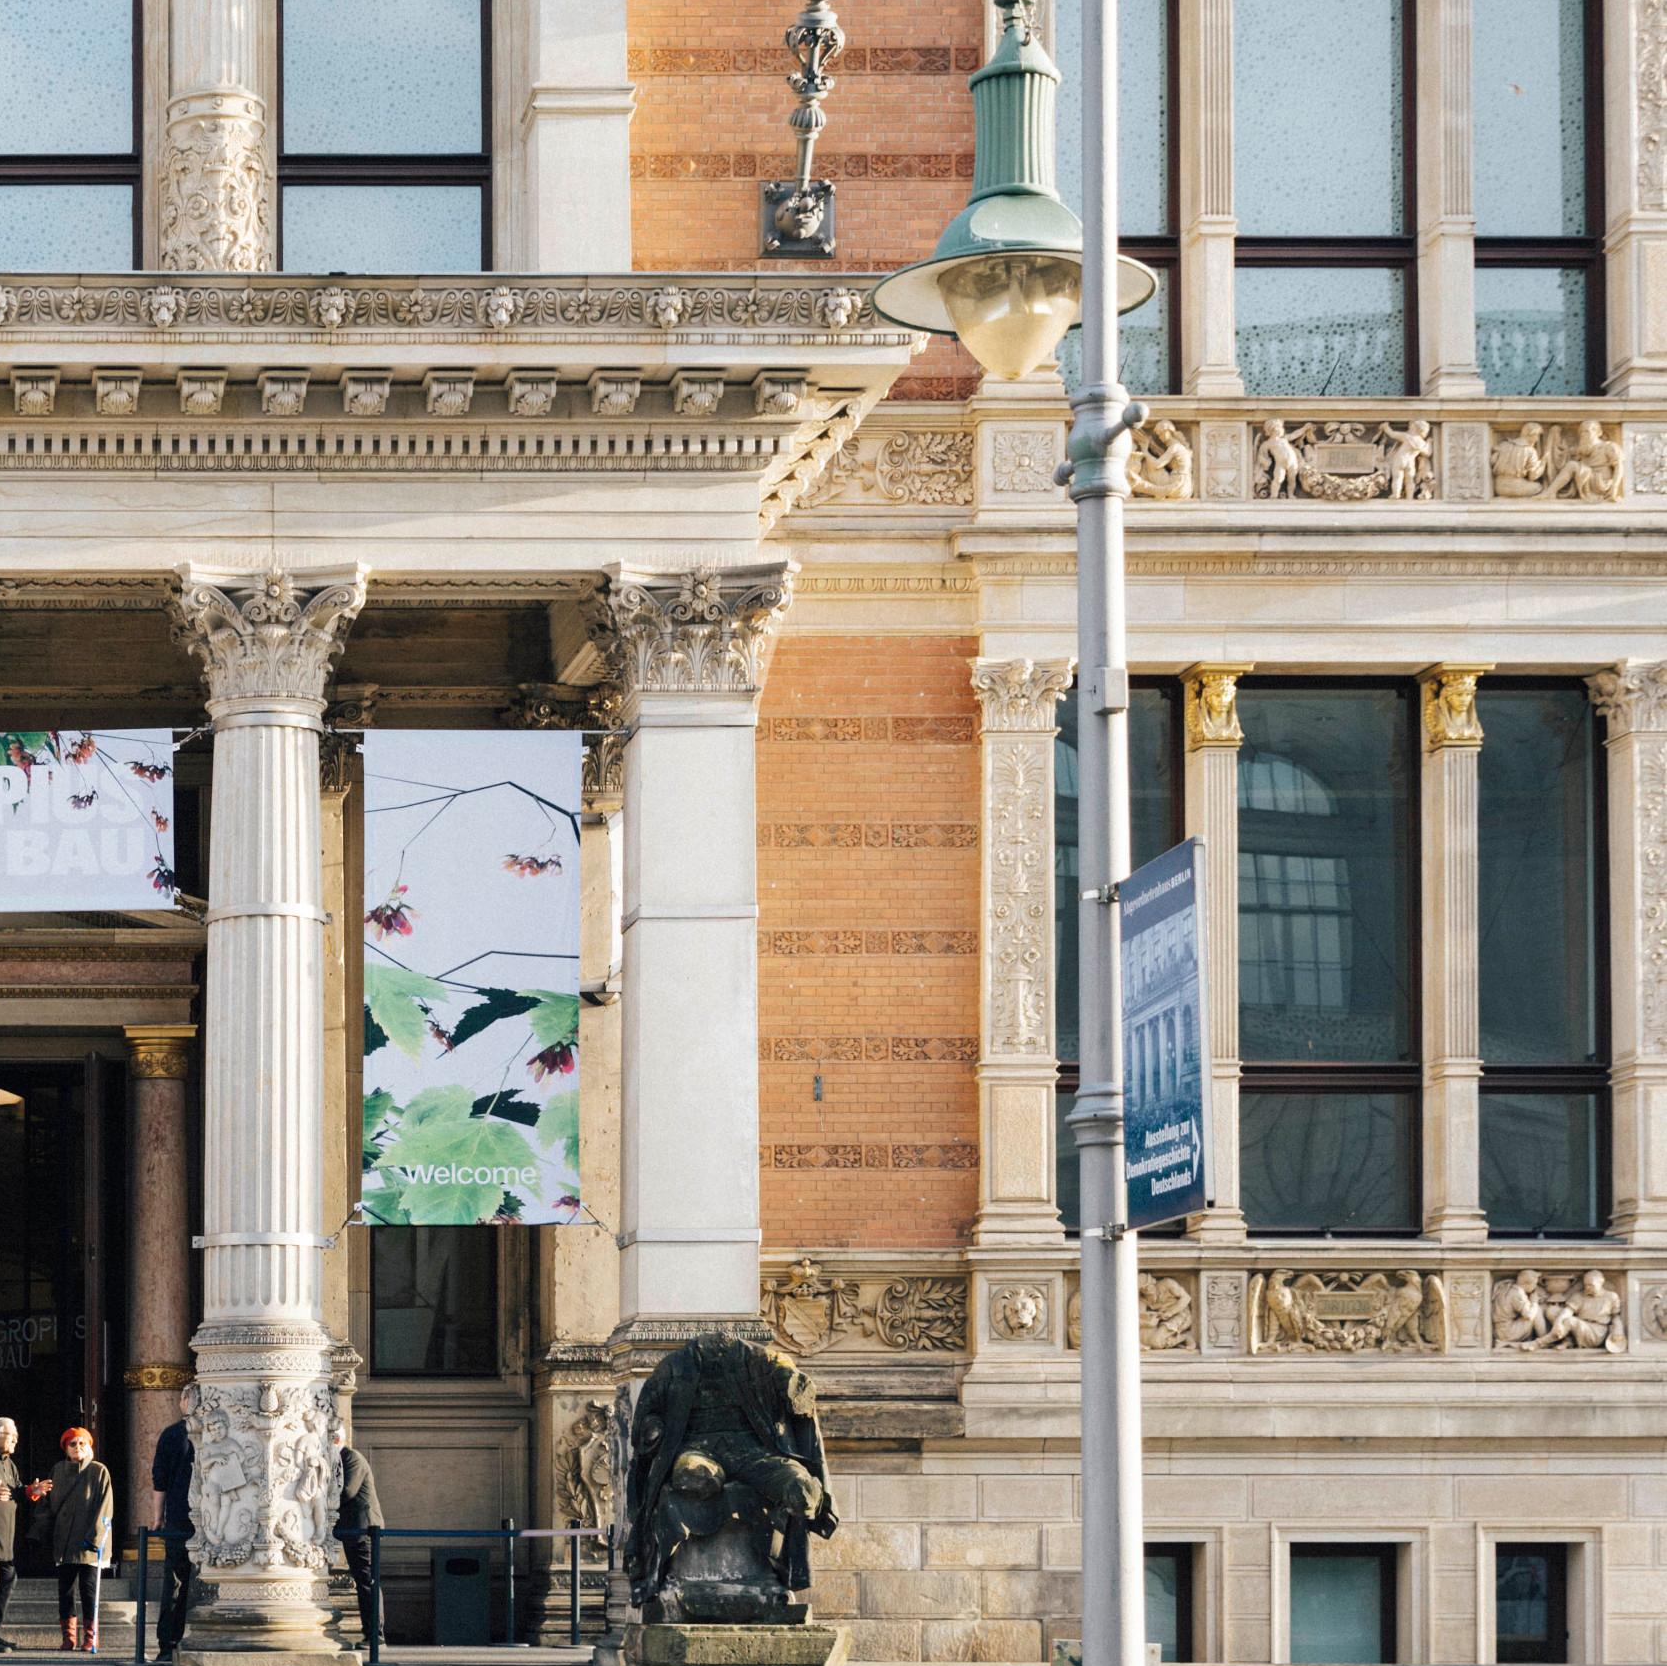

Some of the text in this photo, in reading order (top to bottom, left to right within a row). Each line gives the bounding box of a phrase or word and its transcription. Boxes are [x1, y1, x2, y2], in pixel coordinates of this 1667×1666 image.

[6, 827, 145, 876] BAU
[1145, 1120, 1190, 1149] Ausstellung zur
[406, 1162, 538, 1185] Welcome
[1126, 1143, 1191, 1180] Demokratiegeschichte
[1151, 1167, 1192, 1196] Deutschlands
